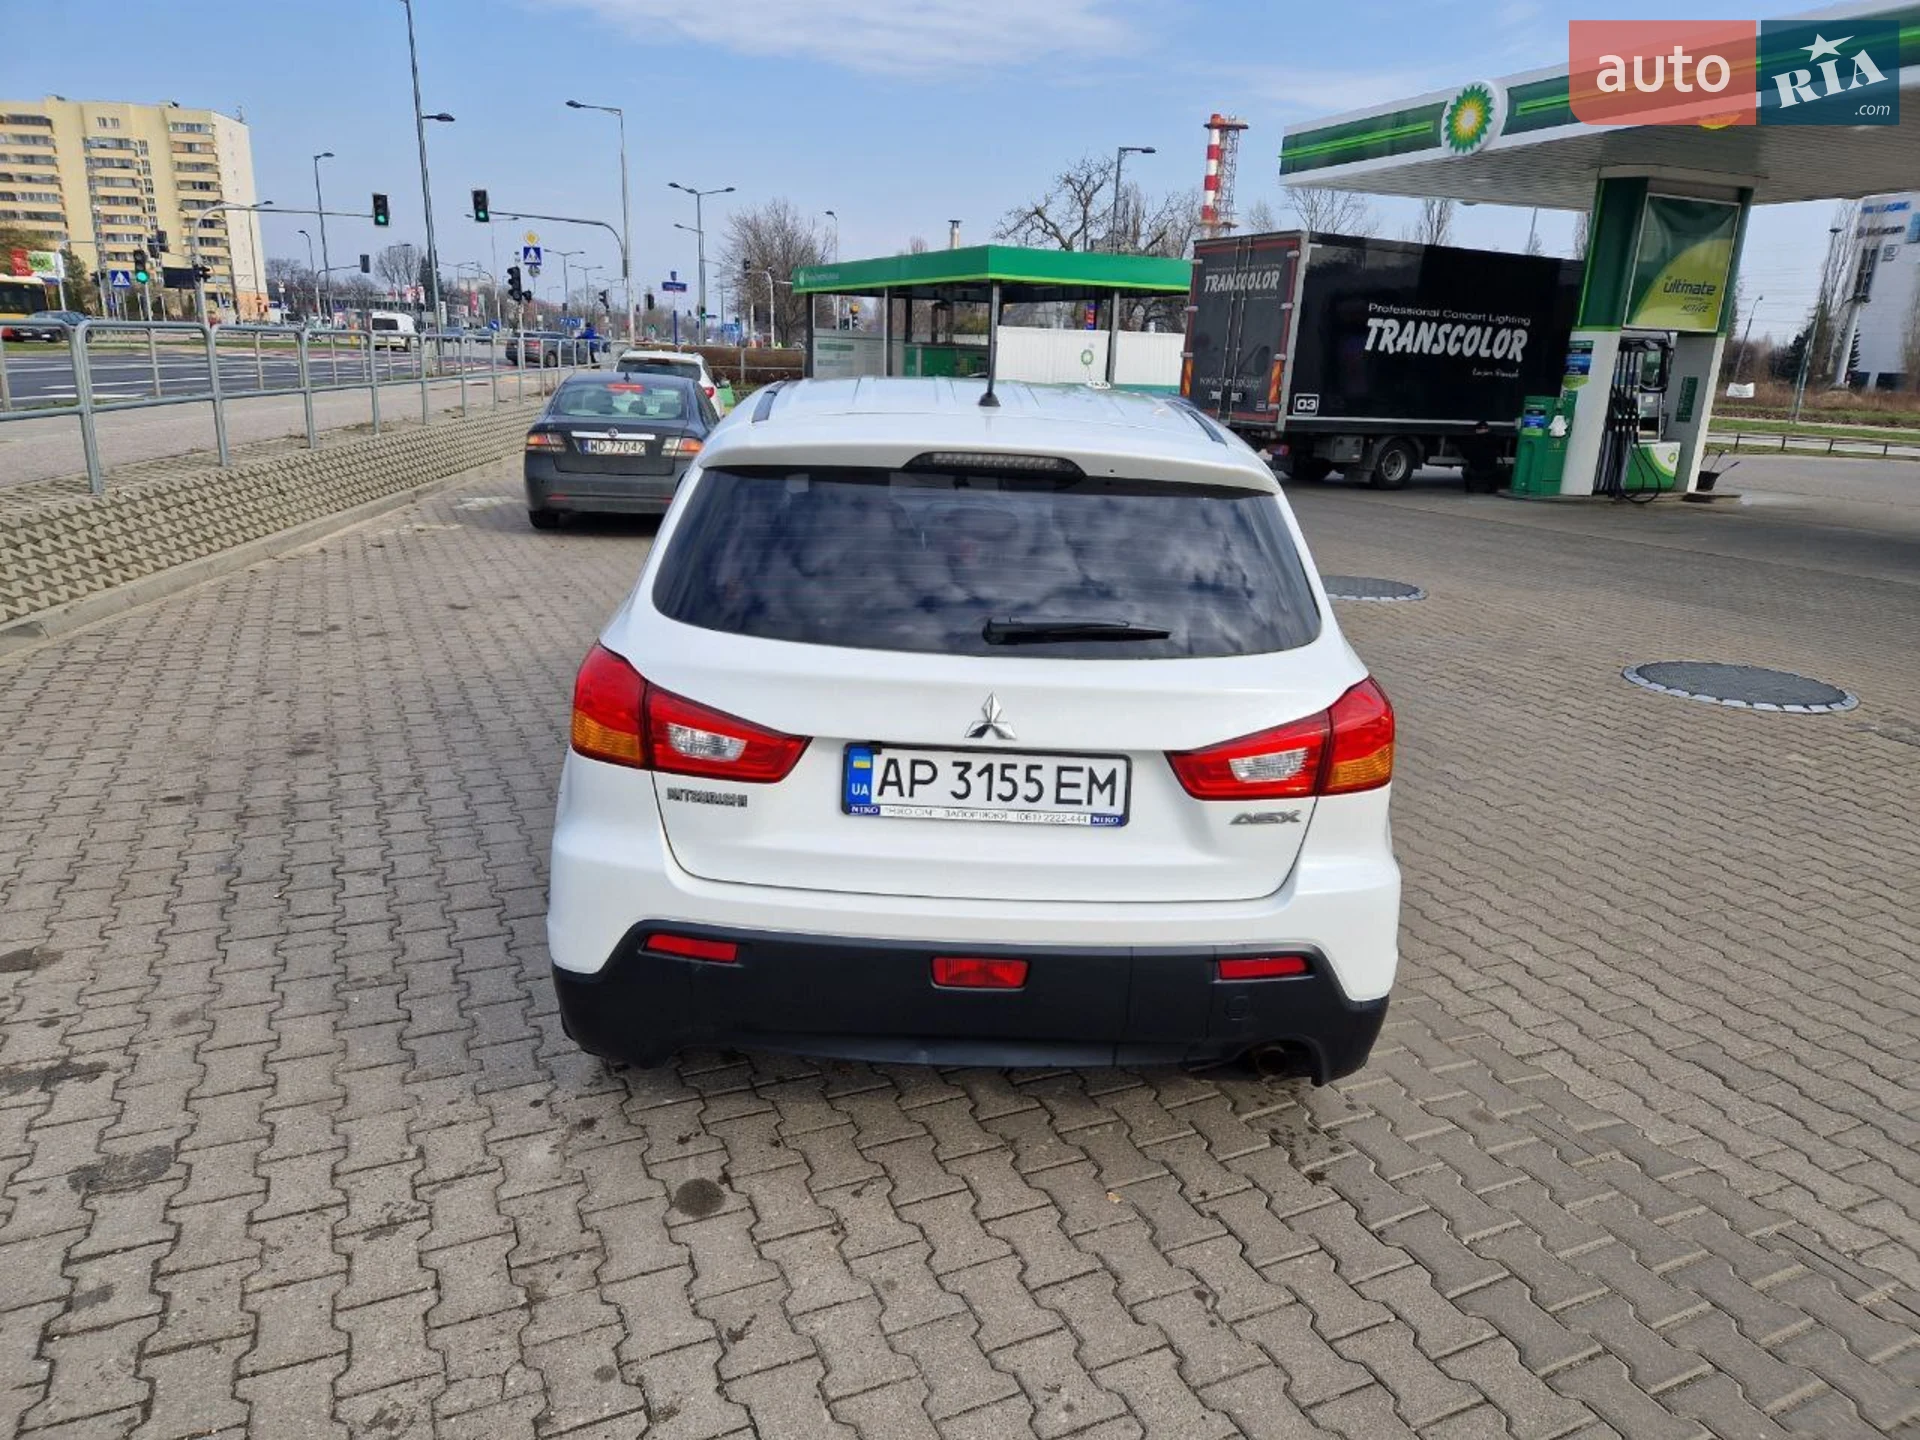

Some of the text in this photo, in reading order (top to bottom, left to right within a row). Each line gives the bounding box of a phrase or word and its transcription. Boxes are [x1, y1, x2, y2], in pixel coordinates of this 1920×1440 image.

[1204, 270, 1280, 293] TRANSCOLOR
[1663, 278, 1717, 296] ultimate
[1368, 302, 1532, 327] Professional Concert Lighting
[1365, 317, 1529, 363] TRANSCOLOR
[1297, 399, 1316, 411] 03
[852, 784, 869, 796] UA
[950, 761, 1044, 803] 3155
[1055, 765, 1117, 807] EM
